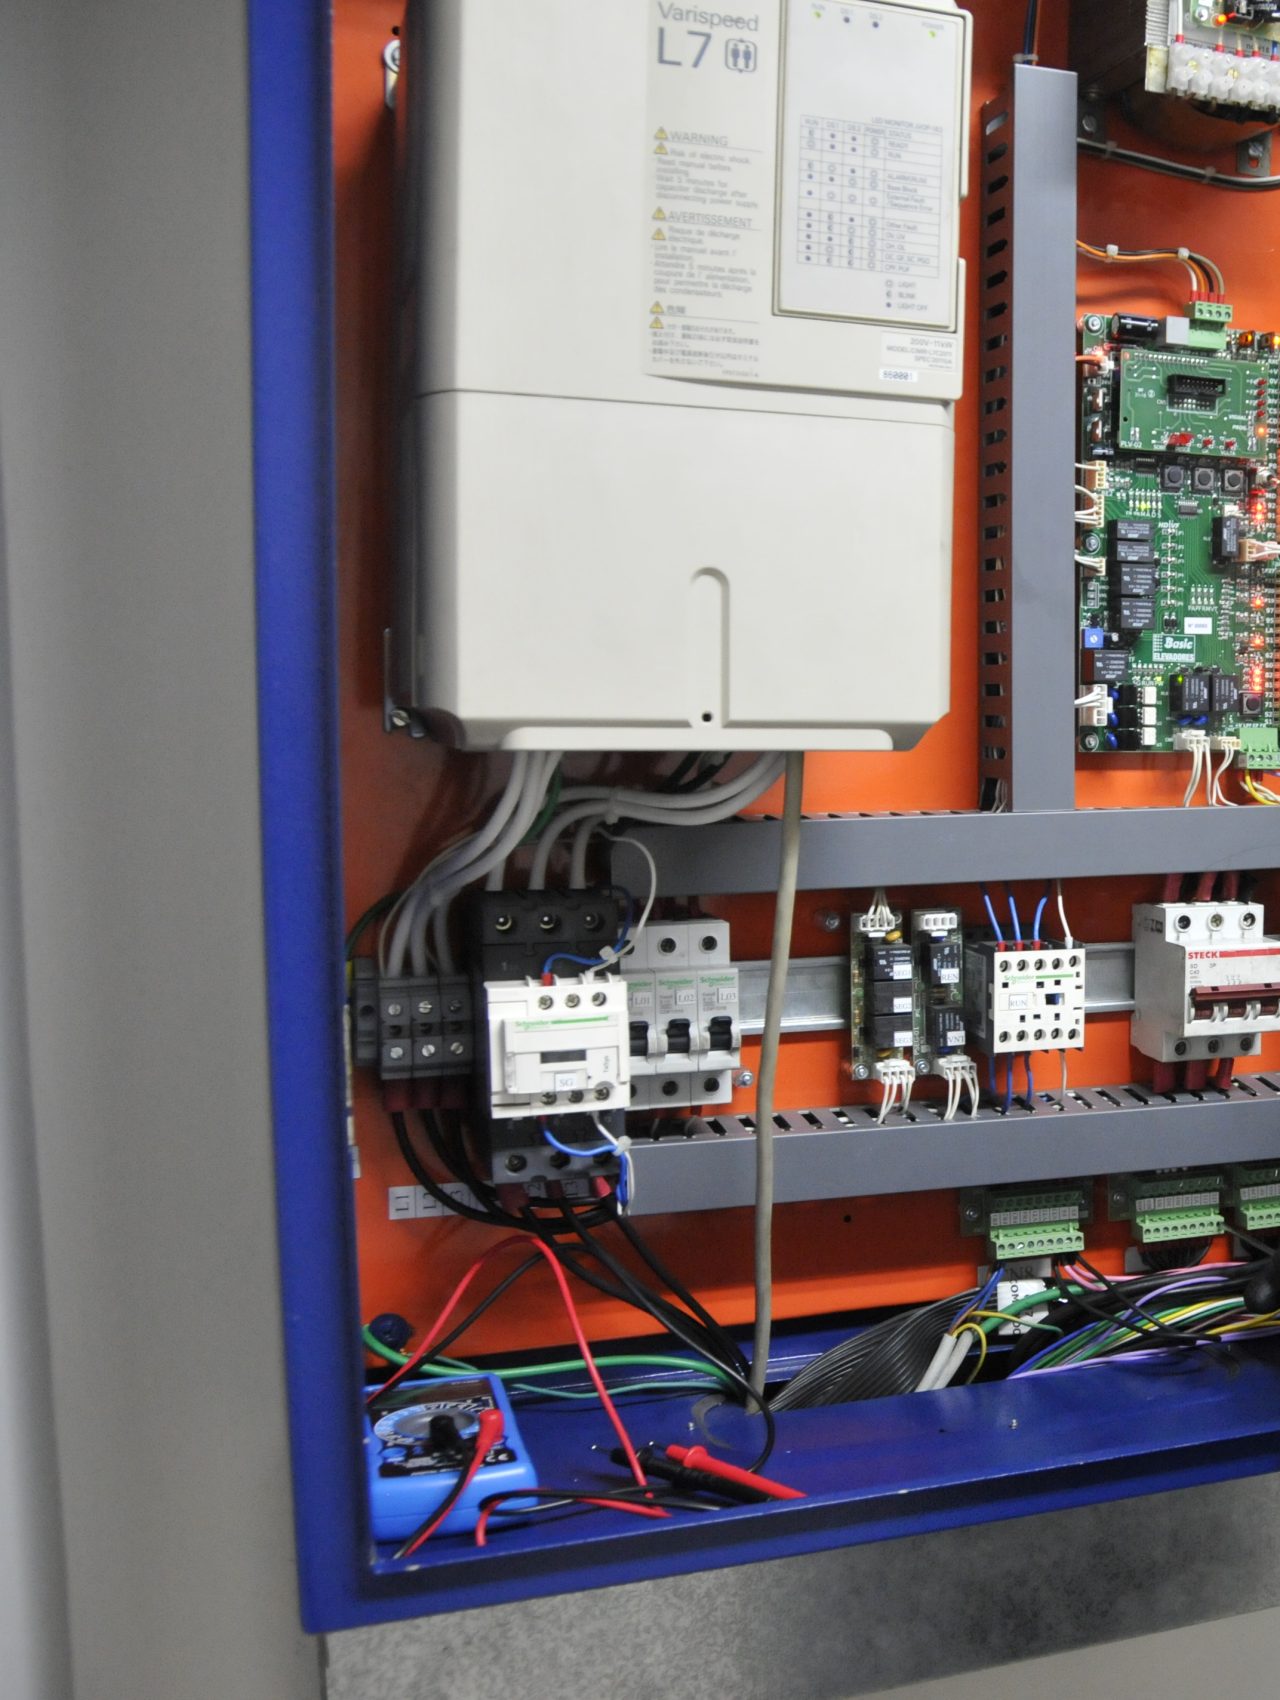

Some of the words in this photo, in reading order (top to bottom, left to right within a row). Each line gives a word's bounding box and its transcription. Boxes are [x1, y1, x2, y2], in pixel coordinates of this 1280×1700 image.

[657, 0, 759, 32] Varispeed
[657, 27, 714, 68] L7
[670, 131, 729, 147] WARNING
[668, 210, 753, 228] AVERTISSEMENT
[1163, 636, 1193, 650] Basic
[1188, 951, 1218, 960] STECK
